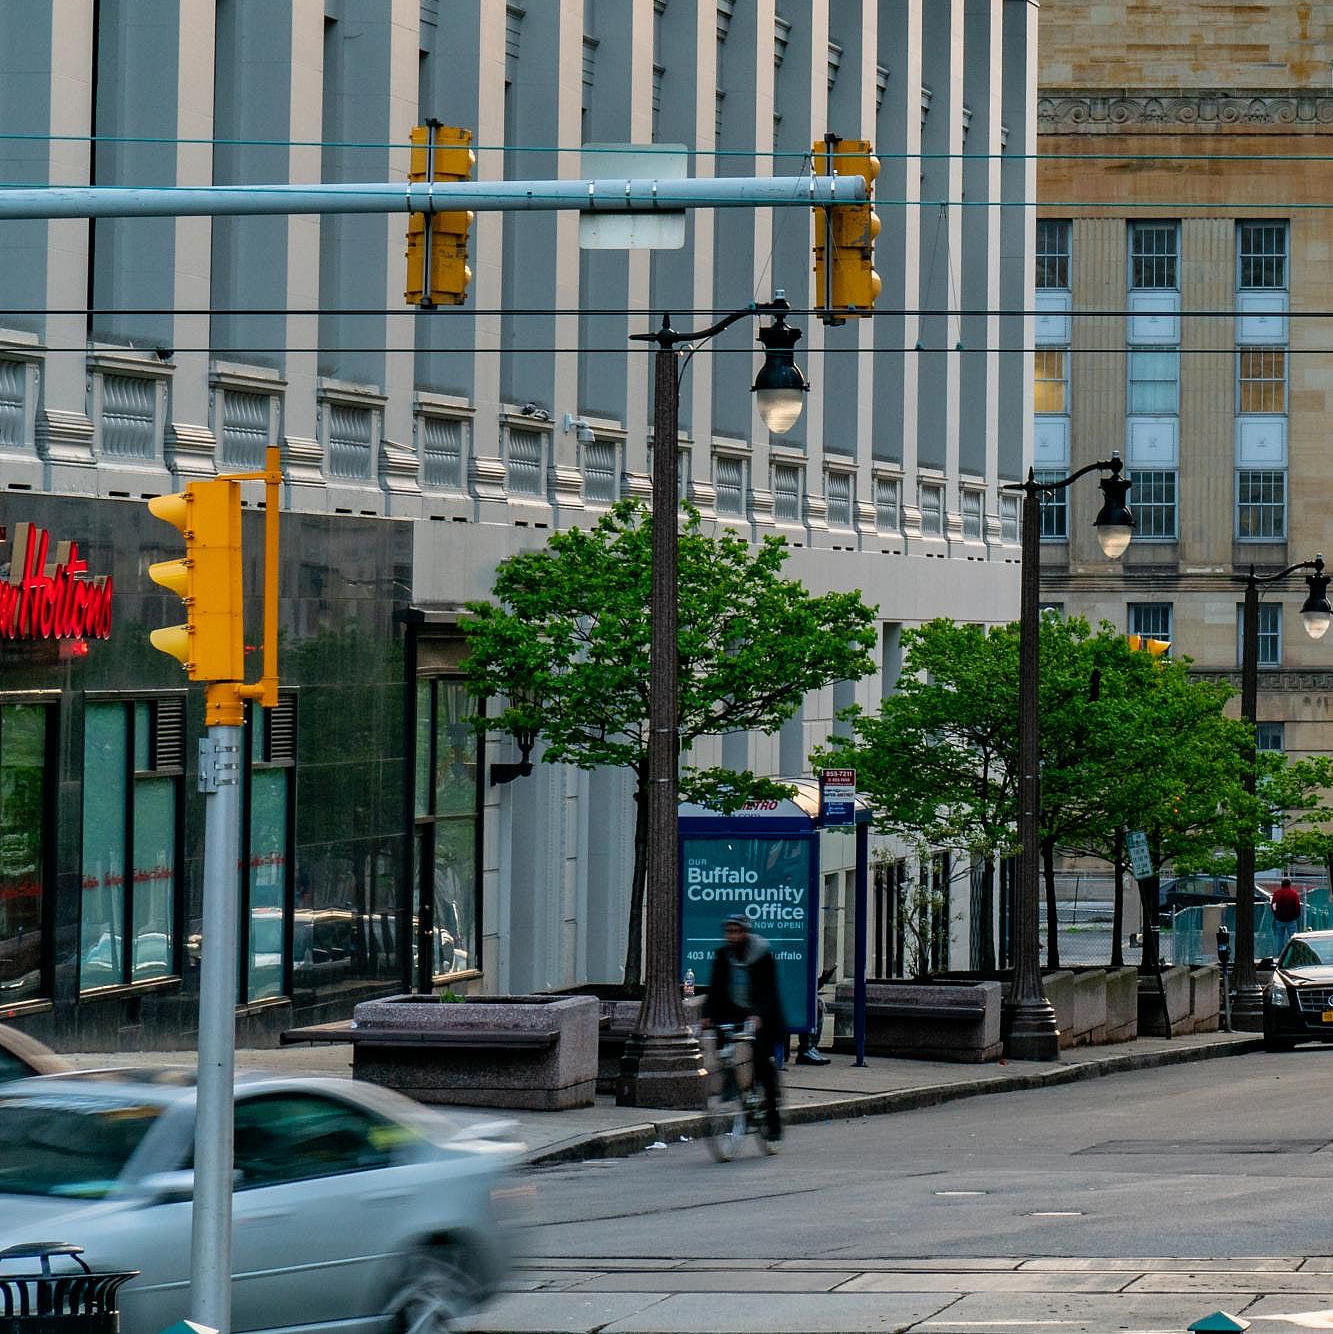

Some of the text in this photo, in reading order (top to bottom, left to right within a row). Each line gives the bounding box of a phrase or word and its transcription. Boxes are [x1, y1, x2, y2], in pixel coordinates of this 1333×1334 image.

[20, 522, 112, 640] Hortons
[688, 867, 758, 883] Buffalo
[687, 885, 804, 904] Community
[745, 903, 804, 920] Office
[687, 951, 704, 960] 403
[771, 951, 802, 960] uffalo
